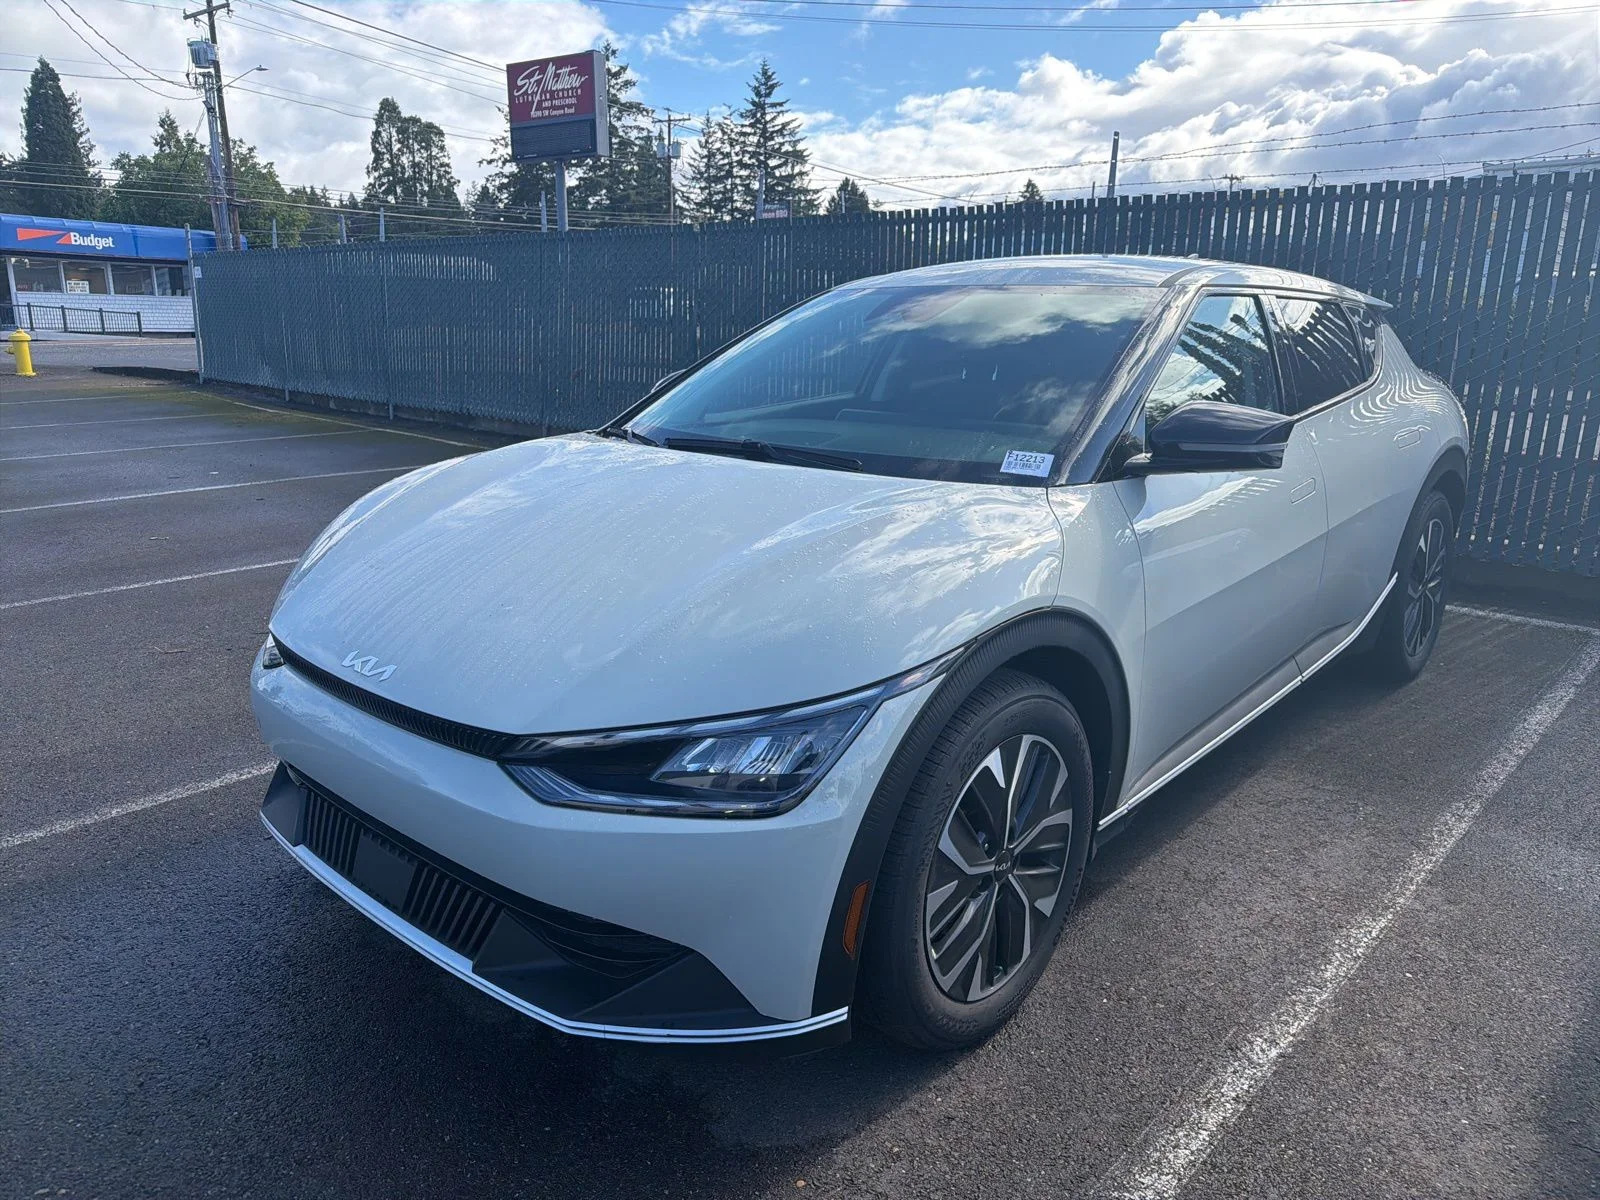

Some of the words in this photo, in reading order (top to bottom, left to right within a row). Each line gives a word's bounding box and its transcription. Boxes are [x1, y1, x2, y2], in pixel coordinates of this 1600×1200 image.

[554, 88, 582, 98] CHURCH
[552, 97, 577, 106] PRESCHOOL
[70, 232, 114, 249] Budget
[341, 649, 398, 682] KIA
